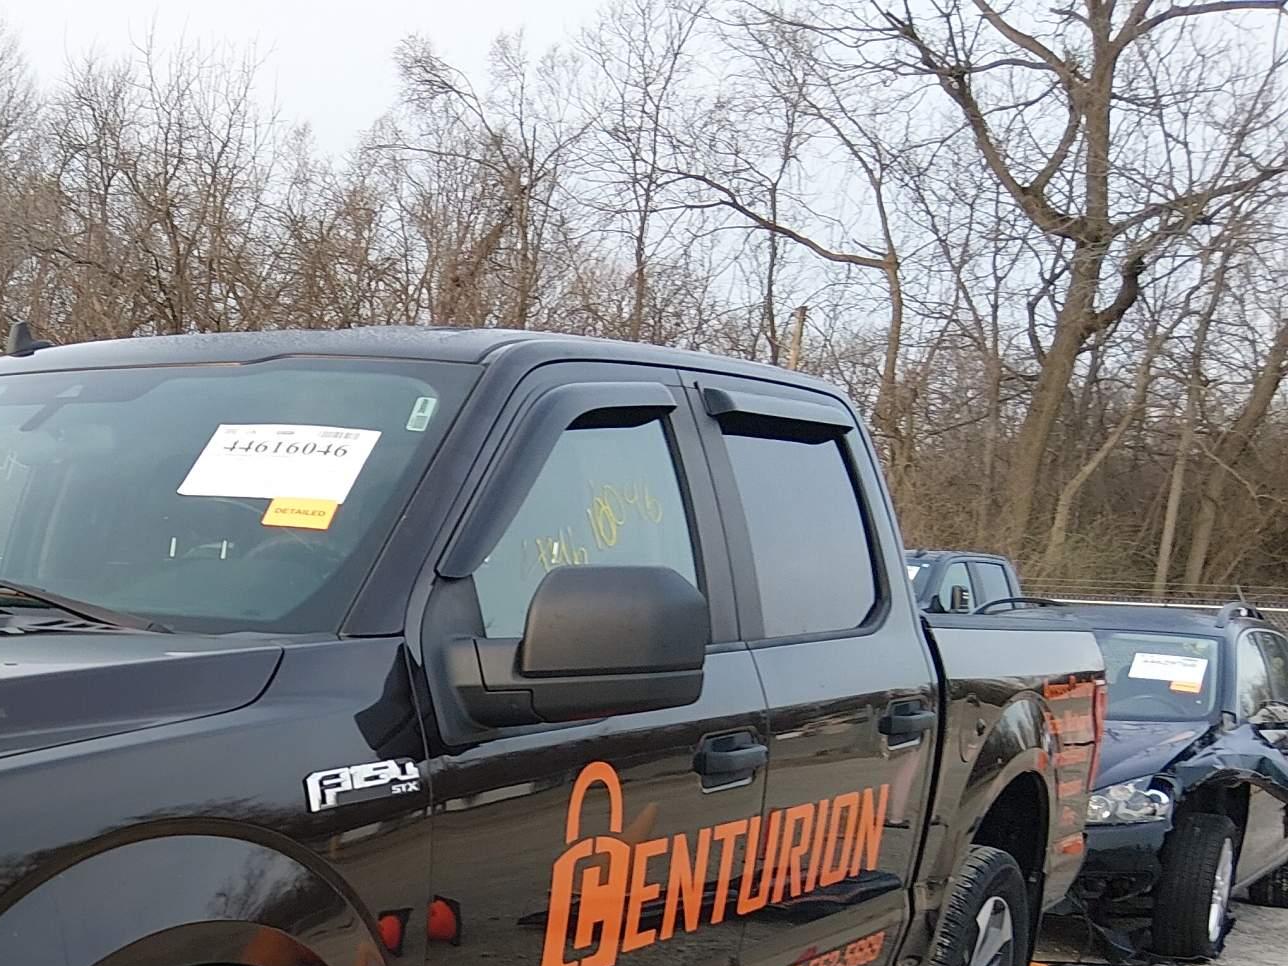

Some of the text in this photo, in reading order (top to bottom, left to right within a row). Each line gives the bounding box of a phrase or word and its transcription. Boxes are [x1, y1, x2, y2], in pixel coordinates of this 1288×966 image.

[223, 439, 349, 458] 44616046
[274, 507, 327, 518] DETAILED
[391, 781, 420, 794] STX
